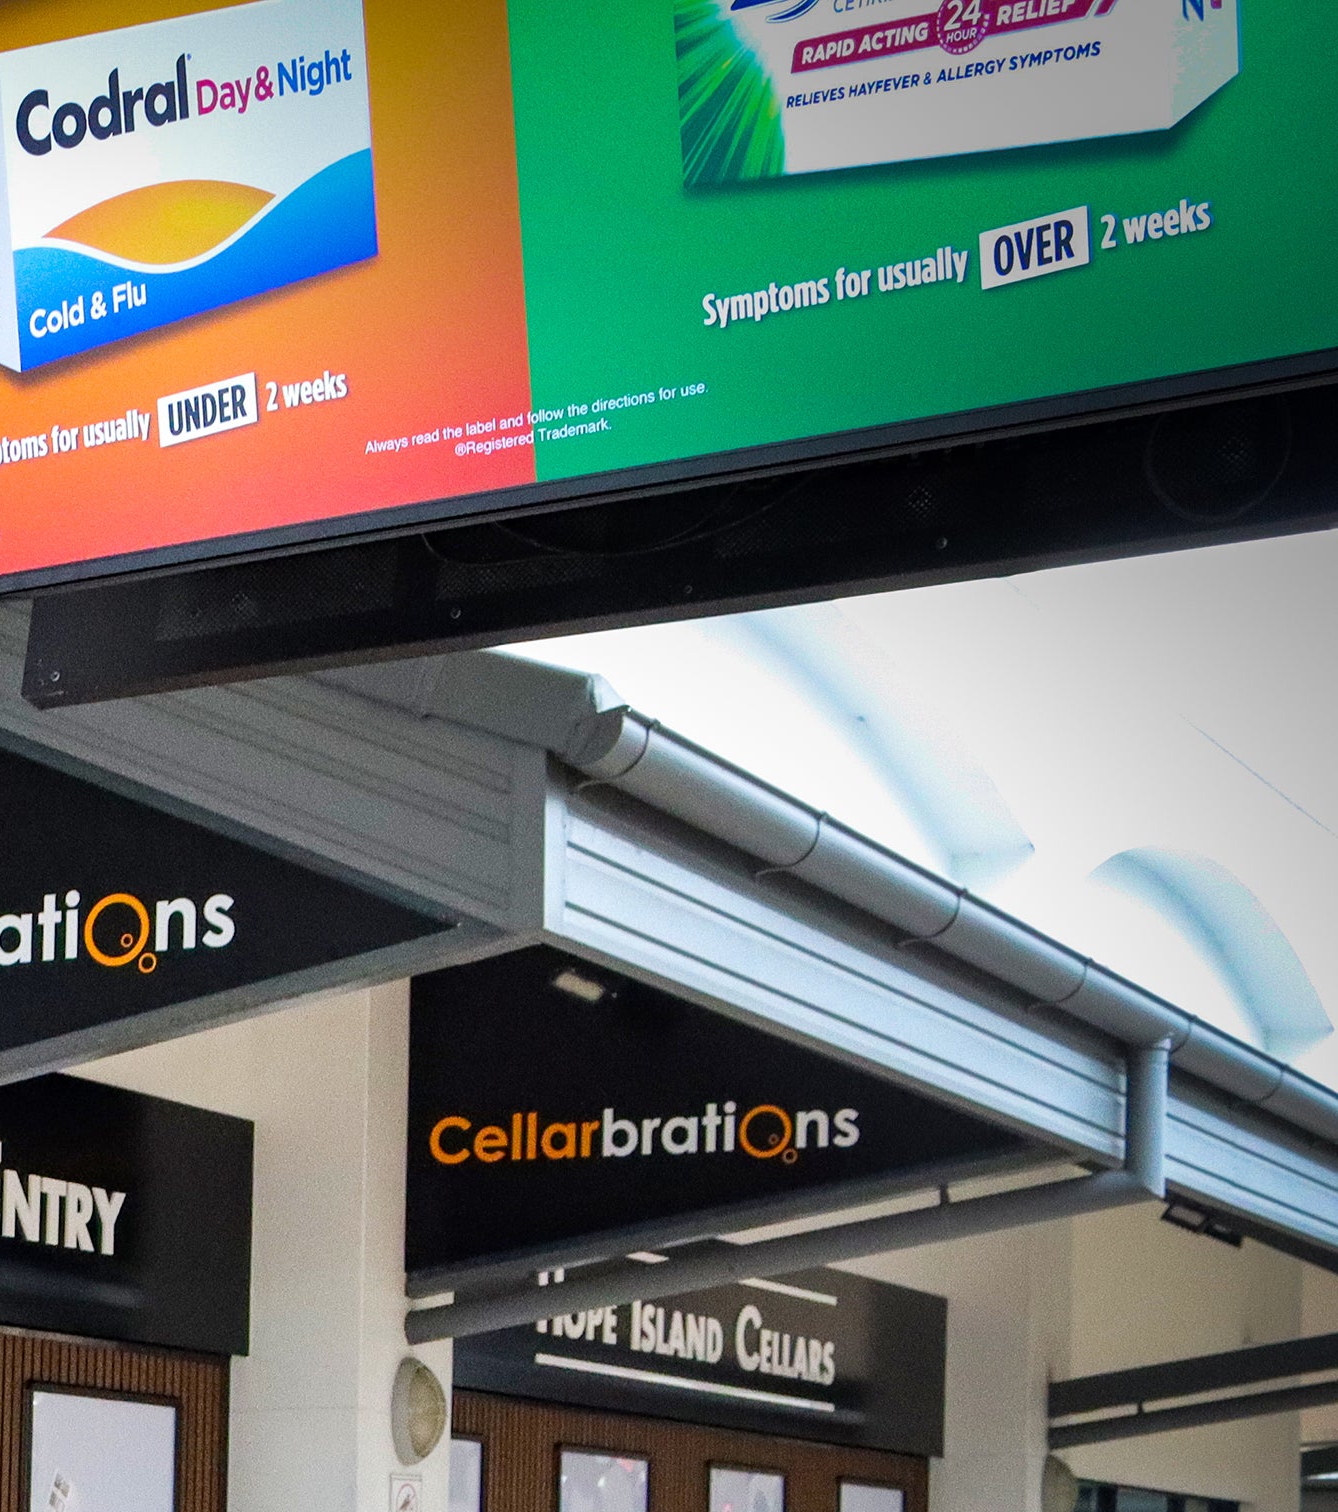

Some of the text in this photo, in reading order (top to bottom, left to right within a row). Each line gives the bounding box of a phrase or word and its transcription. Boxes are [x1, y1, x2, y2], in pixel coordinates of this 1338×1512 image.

[801, 22, 929, 65] RAPID ACTING
[943, 0, 982, 32] 24
[946, 28, 978, 43] HOUR
[996, 0, 1075, 26] RELIEF
[16, 53, 190, 156] Codral
[786, 41, 1101, 108] RELIEVES HAYFEVER & ALLERGY SYMPTOMS
[703, 199, 1212, 328] Symptoms for usually OVER 2 weeks
[29, 281, 147, 338] Cold & Flu
[51, 425, 79, 453] for
[83, 409, 151, 448] usually
[168, 384, 248, 437] UNDER
[265, 382, 279, 411] 2
[282, 370, 349, 408] weeks
[365, 382, 709, 455] Always read the label and follow the directions for use.
[538, 418, 612, 442] Trademark.
[630, 1299, 723, 1364] ISLAND
[735, 1304, 836, 1386] CELLARS
